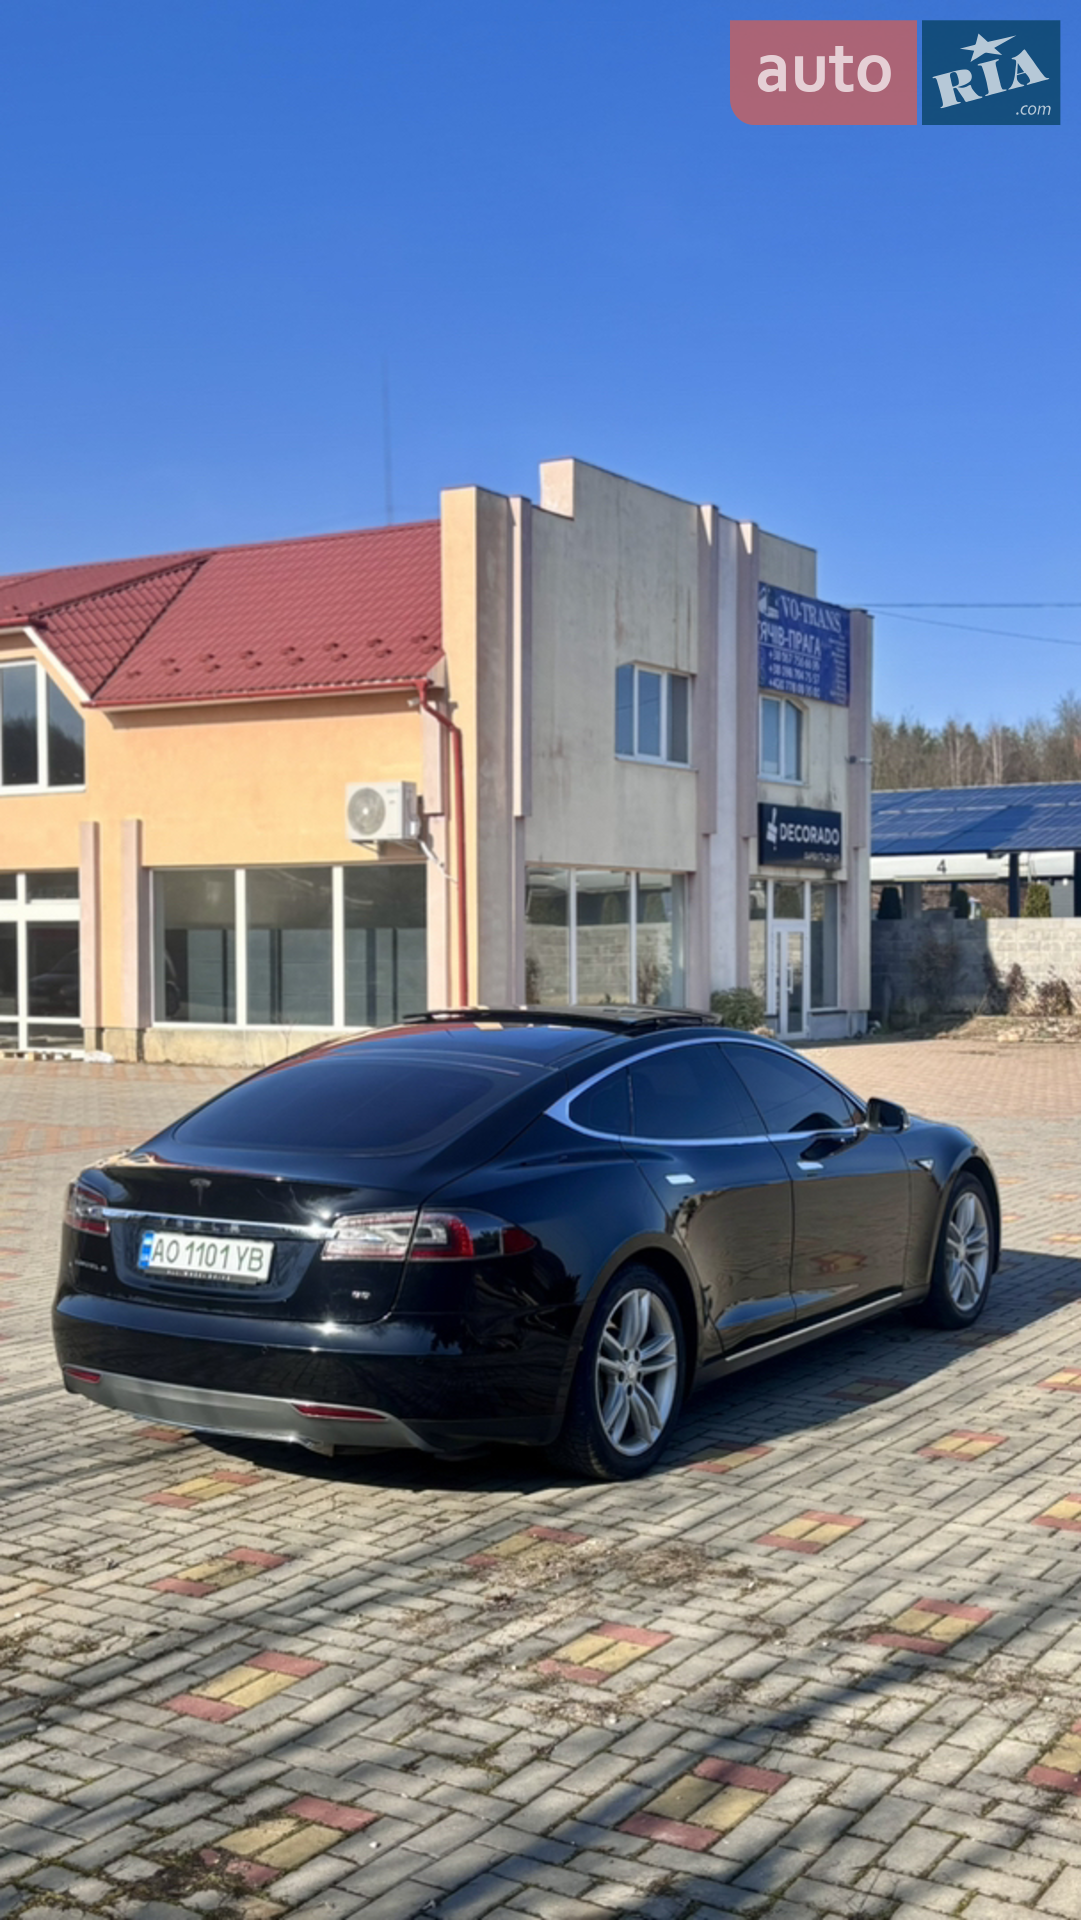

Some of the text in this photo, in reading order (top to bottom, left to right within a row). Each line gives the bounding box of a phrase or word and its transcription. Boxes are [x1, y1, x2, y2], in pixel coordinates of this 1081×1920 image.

[780, 823, 840, 845] DECORADO
[937, 859, 947, 874] 4
[152, 1239, 264, 1272] AO 1101 YB
